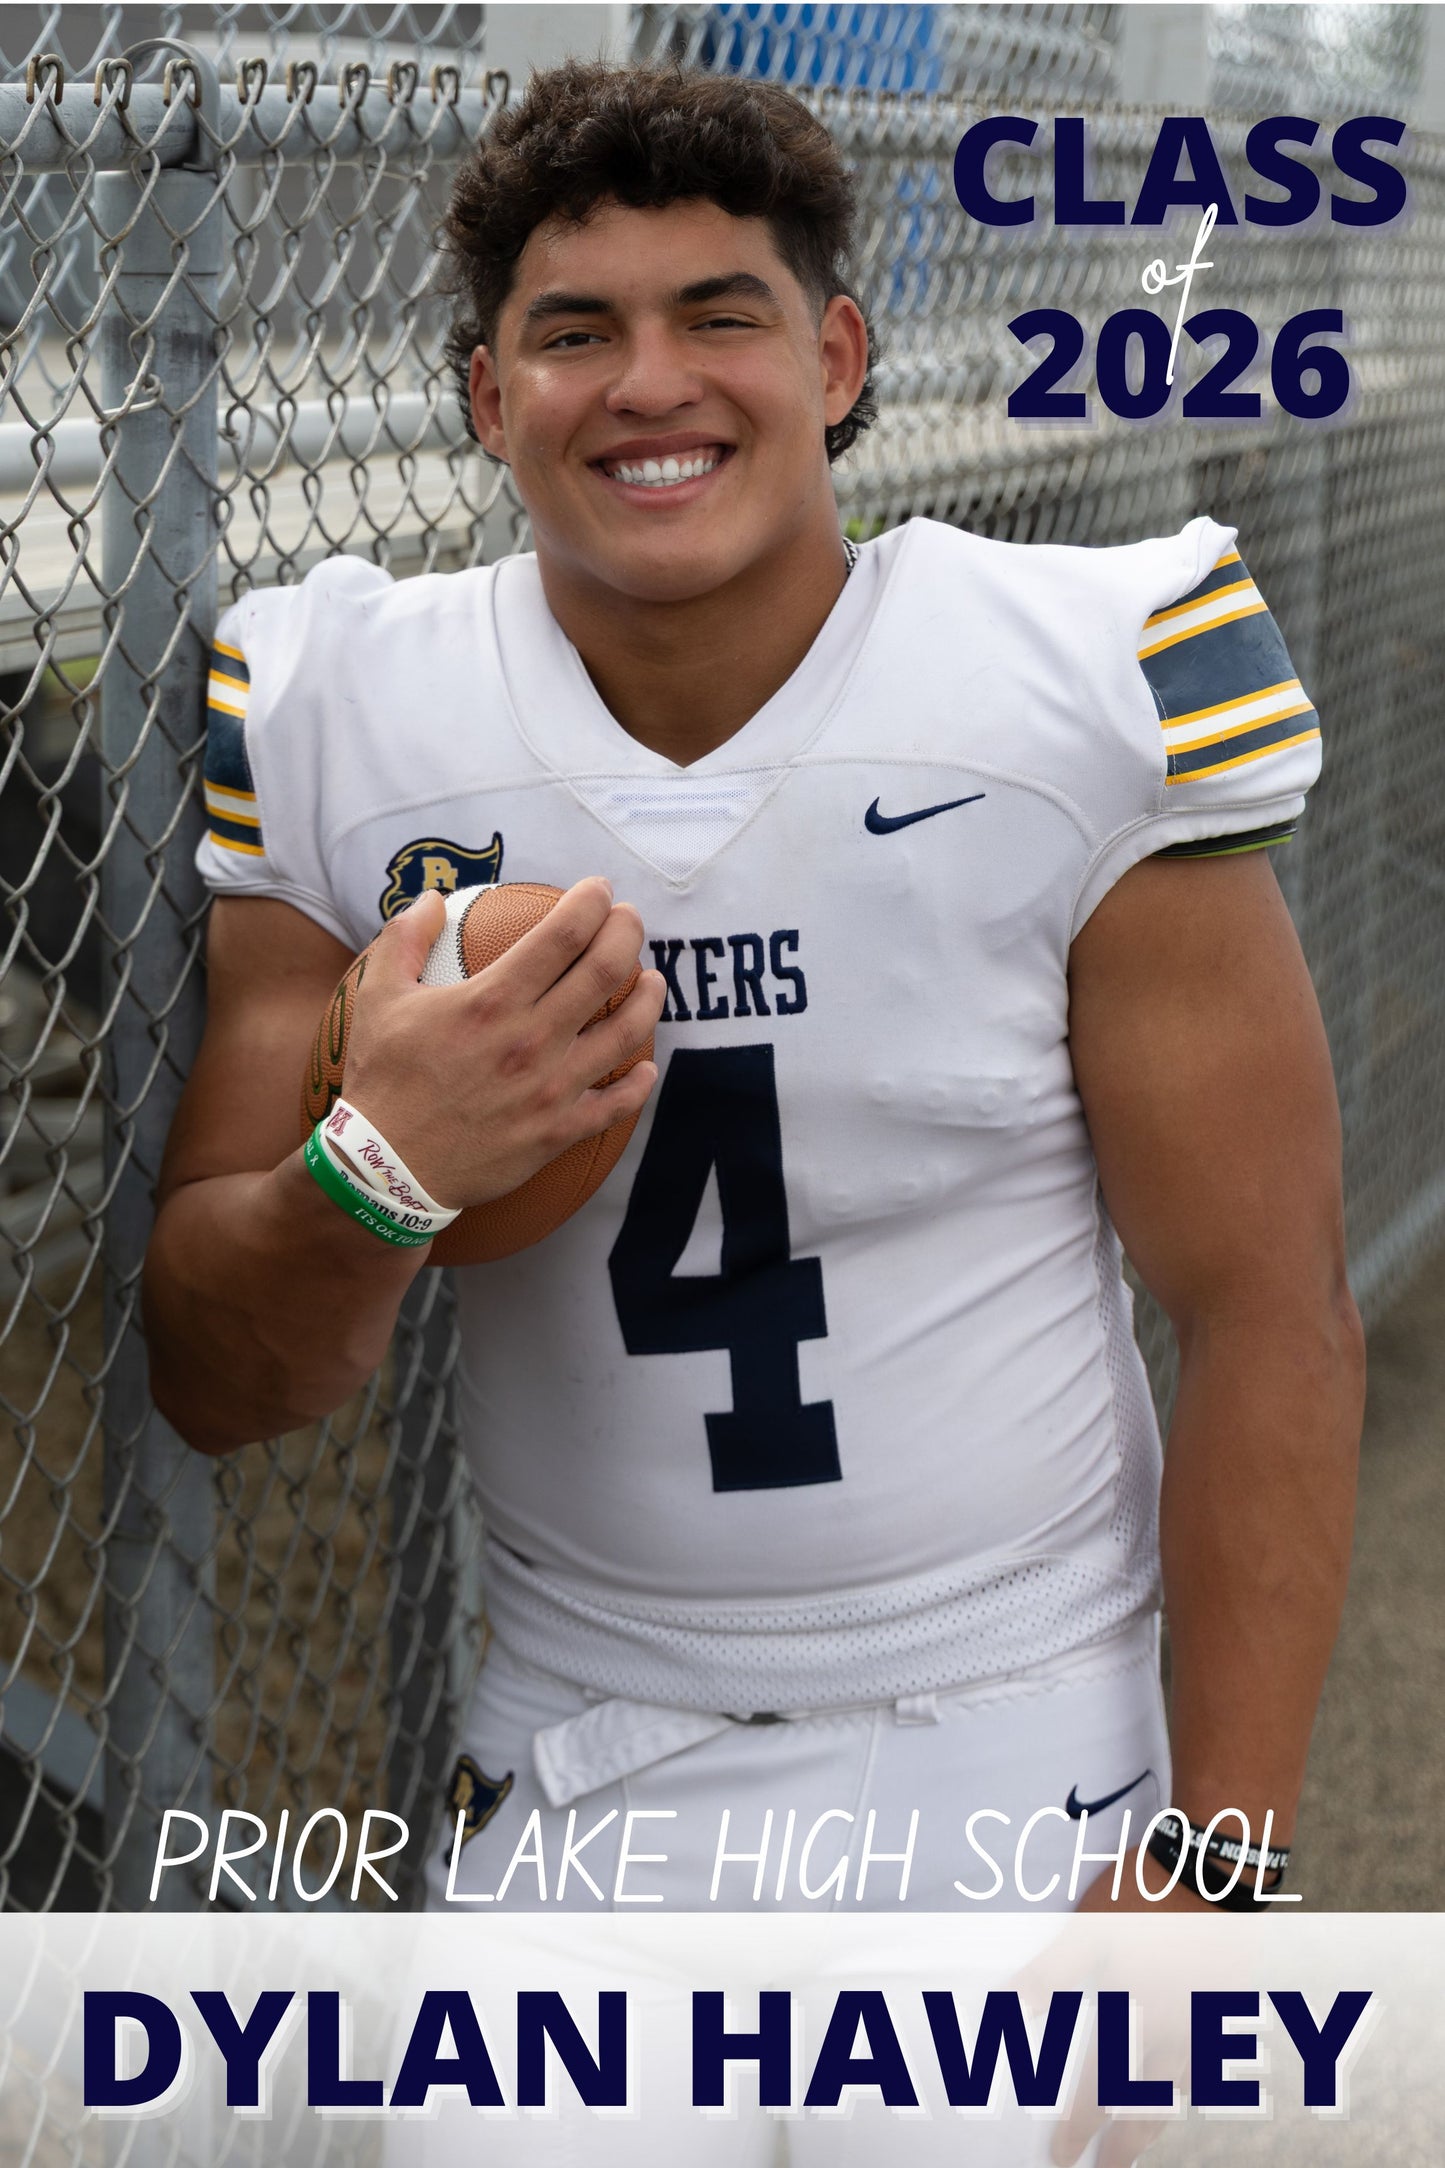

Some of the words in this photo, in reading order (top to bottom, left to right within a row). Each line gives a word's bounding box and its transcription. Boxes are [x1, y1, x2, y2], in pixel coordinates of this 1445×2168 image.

[649, 929, 808, 1021] KERS
[376, 1223, 398, 1239] OK
[399, 1212, 432, 1231] 10:9
[608, 1043, 843, 1492] 4
[1219, 1840, 1281, 1869] PASSON
